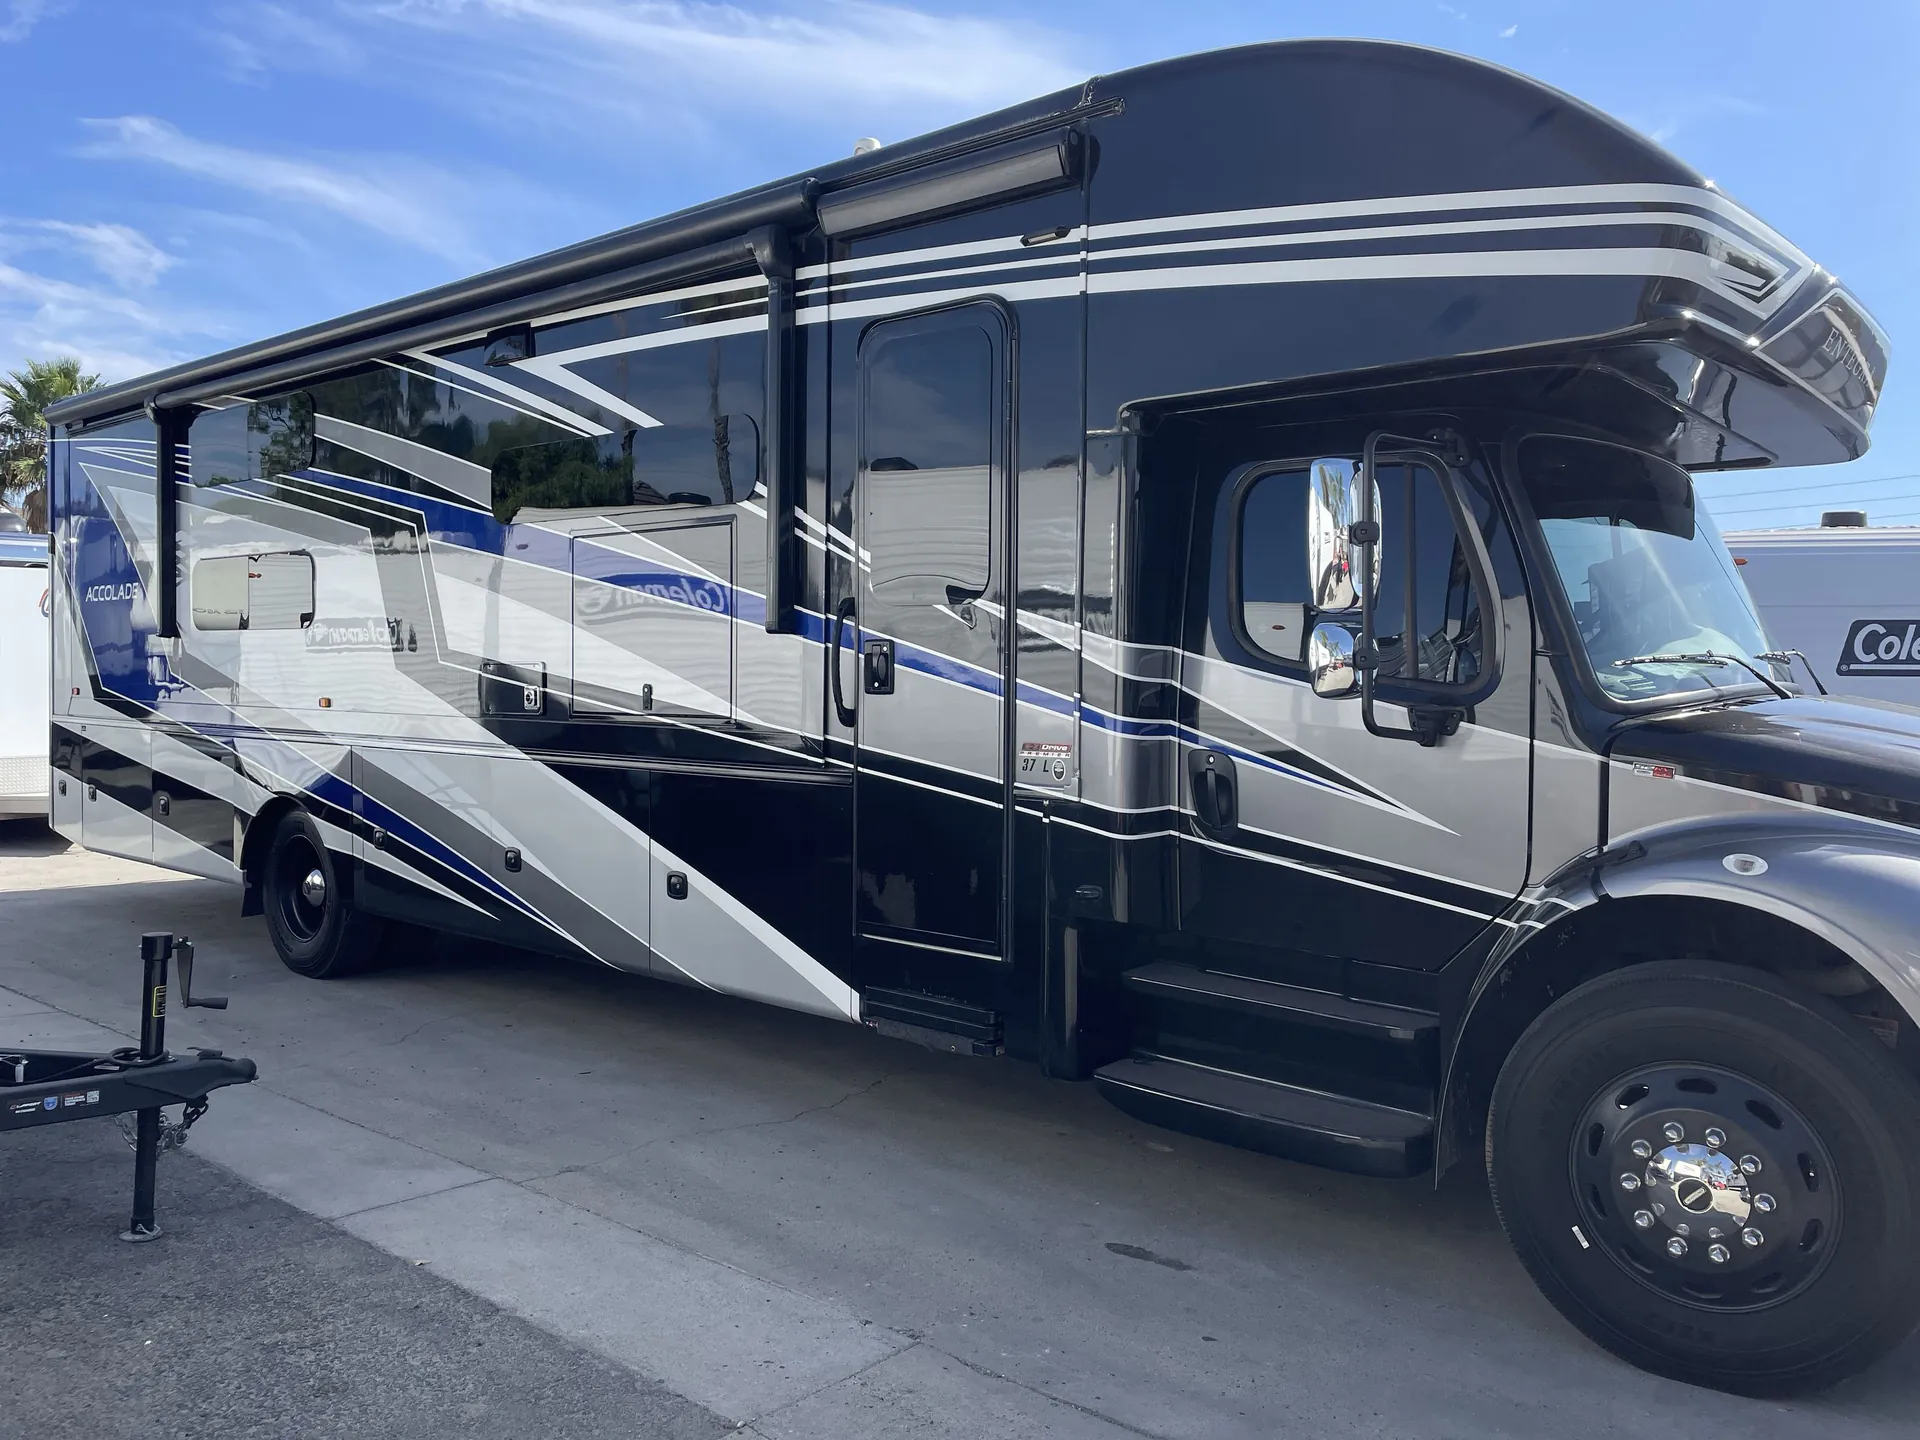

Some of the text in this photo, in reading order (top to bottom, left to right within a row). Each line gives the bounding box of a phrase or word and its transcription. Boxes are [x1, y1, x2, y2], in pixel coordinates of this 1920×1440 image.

[85, 582, 139, 602] ACCOLADE
[1022, 758, 1037, 772] 37
[1042, 759, 1050, 773] L
